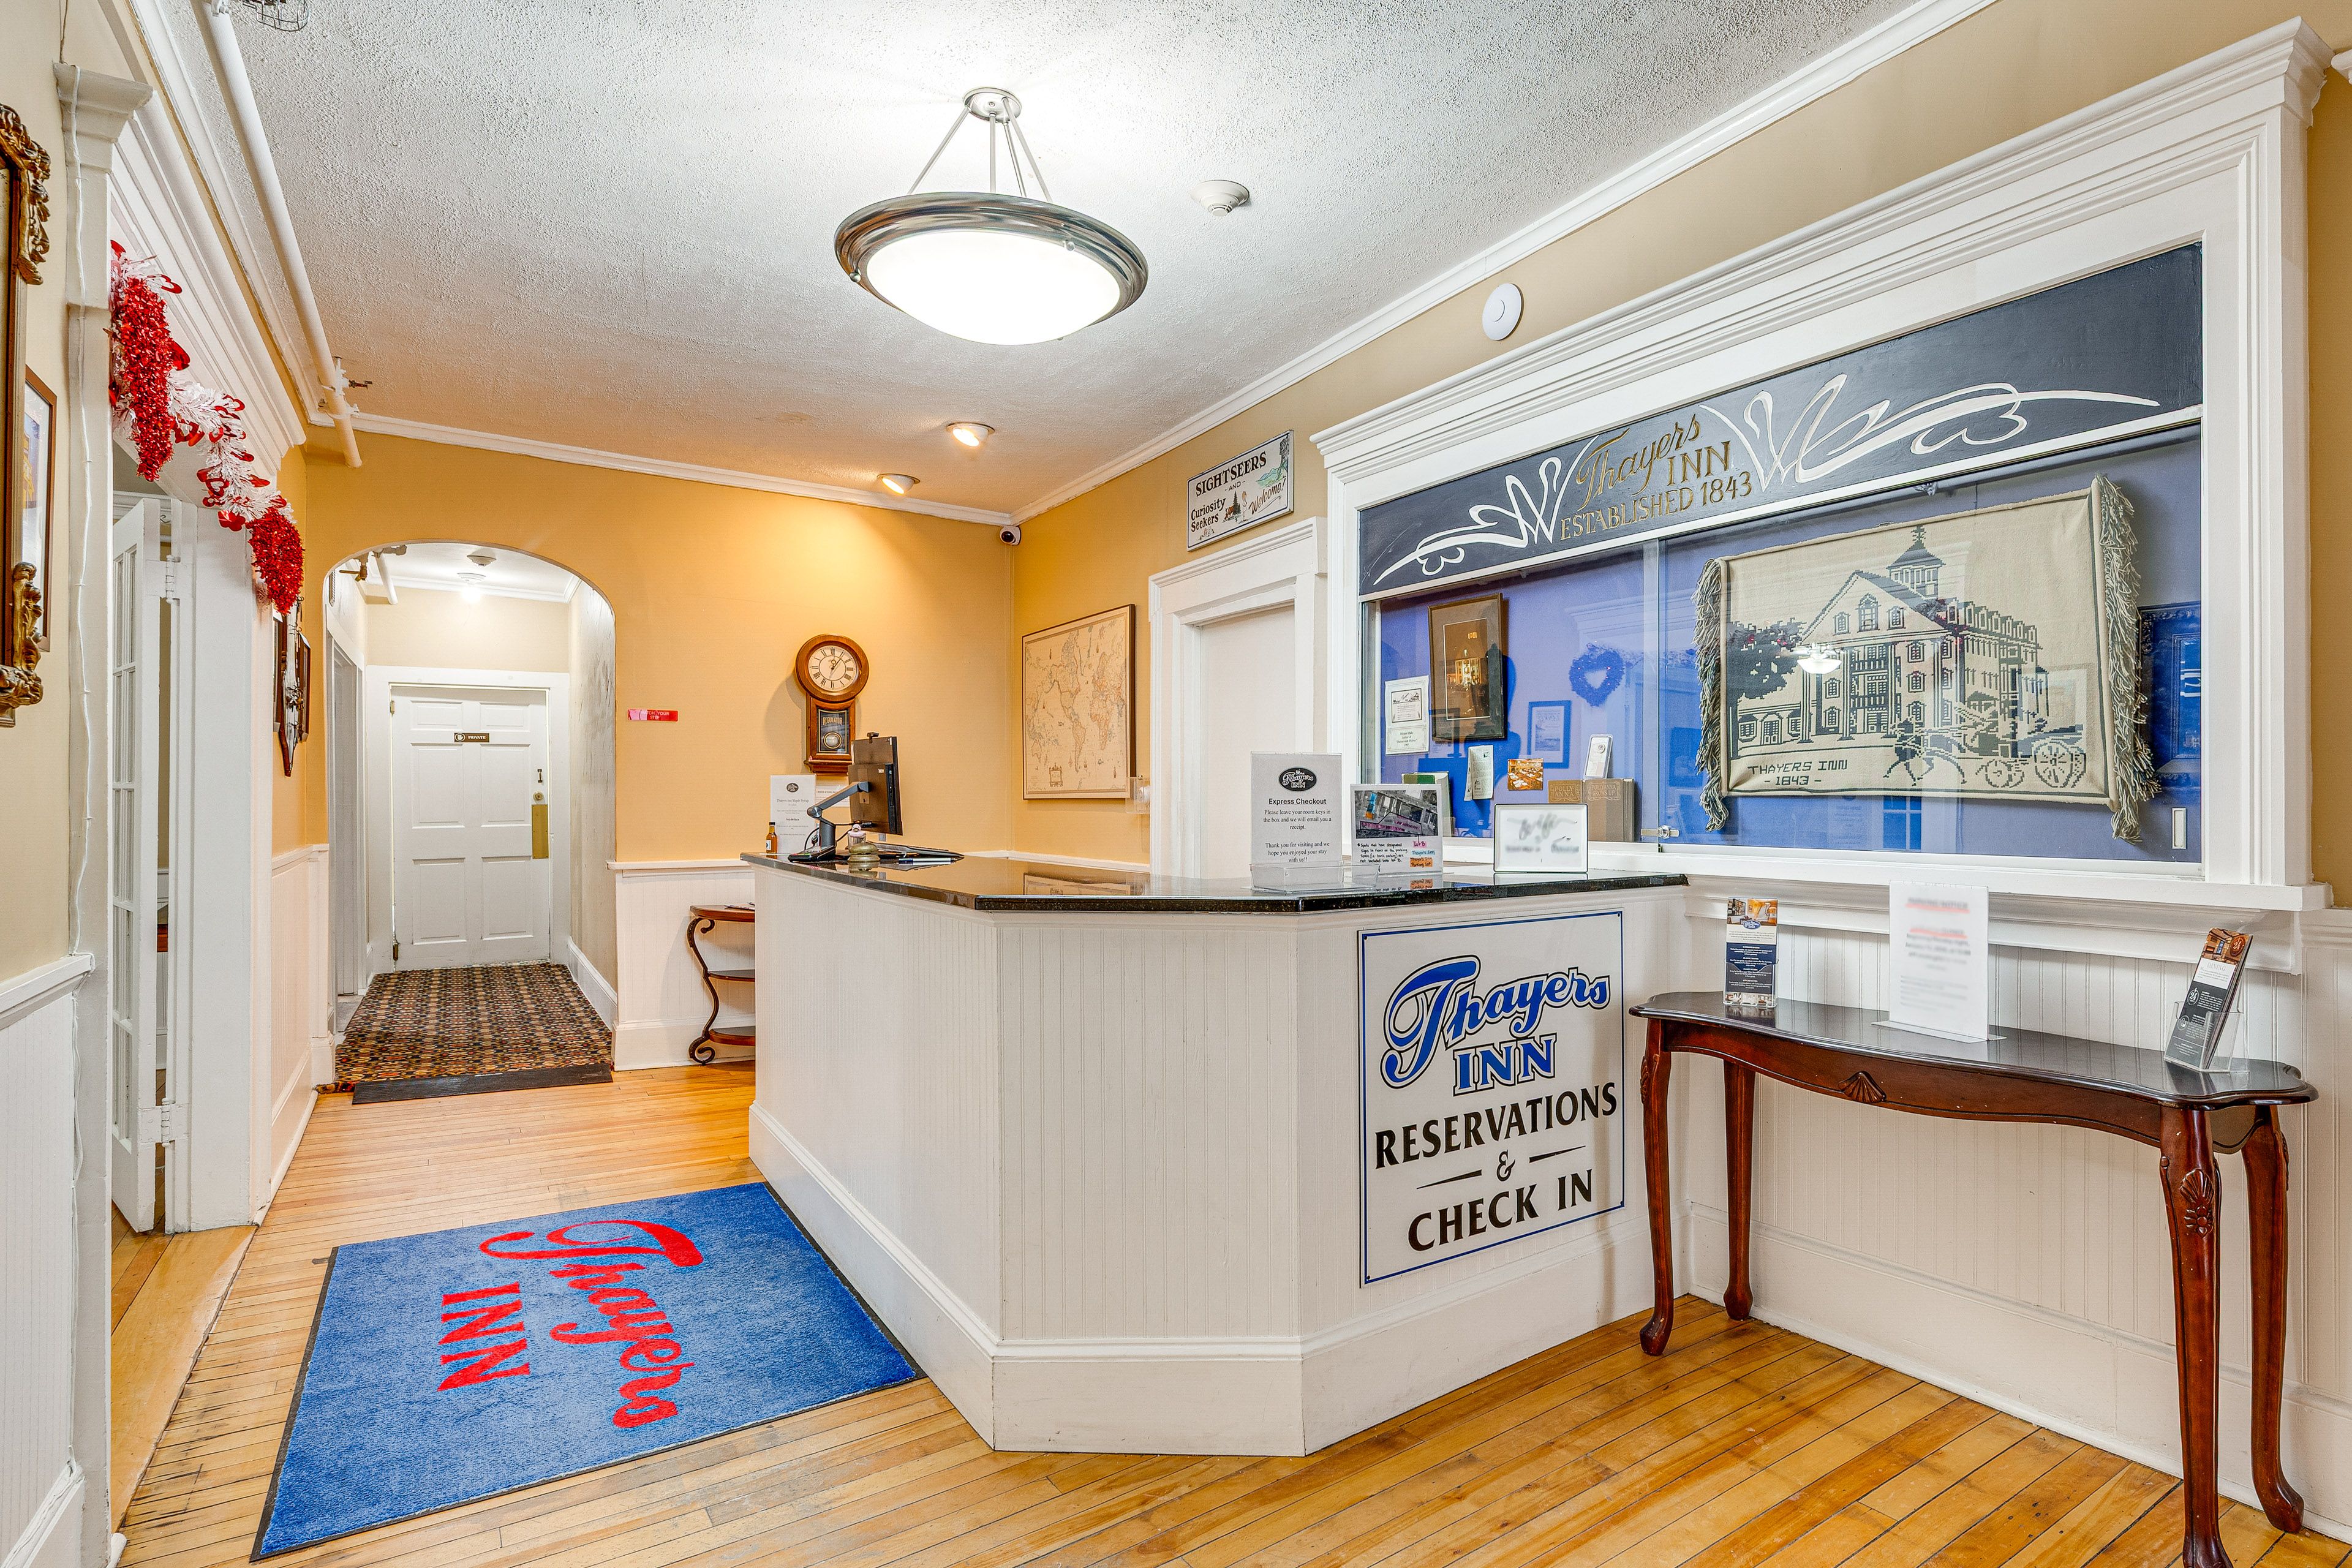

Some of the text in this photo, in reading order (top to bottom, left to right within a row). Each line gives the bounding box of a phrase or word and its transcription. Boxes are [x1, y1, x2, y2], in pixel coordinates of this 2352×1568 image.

[1196, 450, 1267, 497] SIGHTSEERS
[1577, 414, 1700, 511] Thayers
[1667, 440, 1731, 486] INN
[1191, 498, 1226, 521] Curiosity
[1228, 483, 1242, 492] AND
[1248, 478, 1286, 515] Welcome!
[1561, 471, 1752, 540] ESTABLISHED 1843
[1191, 513, 1219, 532] Seekers
[823, 717, 843, 725] REGULATOR
[1747, 760, 1848, 775] THAYERS INN
[1776, 775, 1809, 786] 1843
[1381, 954, 1611, 1088] Thayers
[1453, 1032, 1557, 1096] INN
[1375, 1082, 1617, 1169] RESERVATIONS
[1496, 1150, 1515, 1182] &
[1408, 1169, 1593, 1251] CHECK IN
[437, 1282, 530, 1392] INN
[479, 1219, 704, 1428] Thayers
